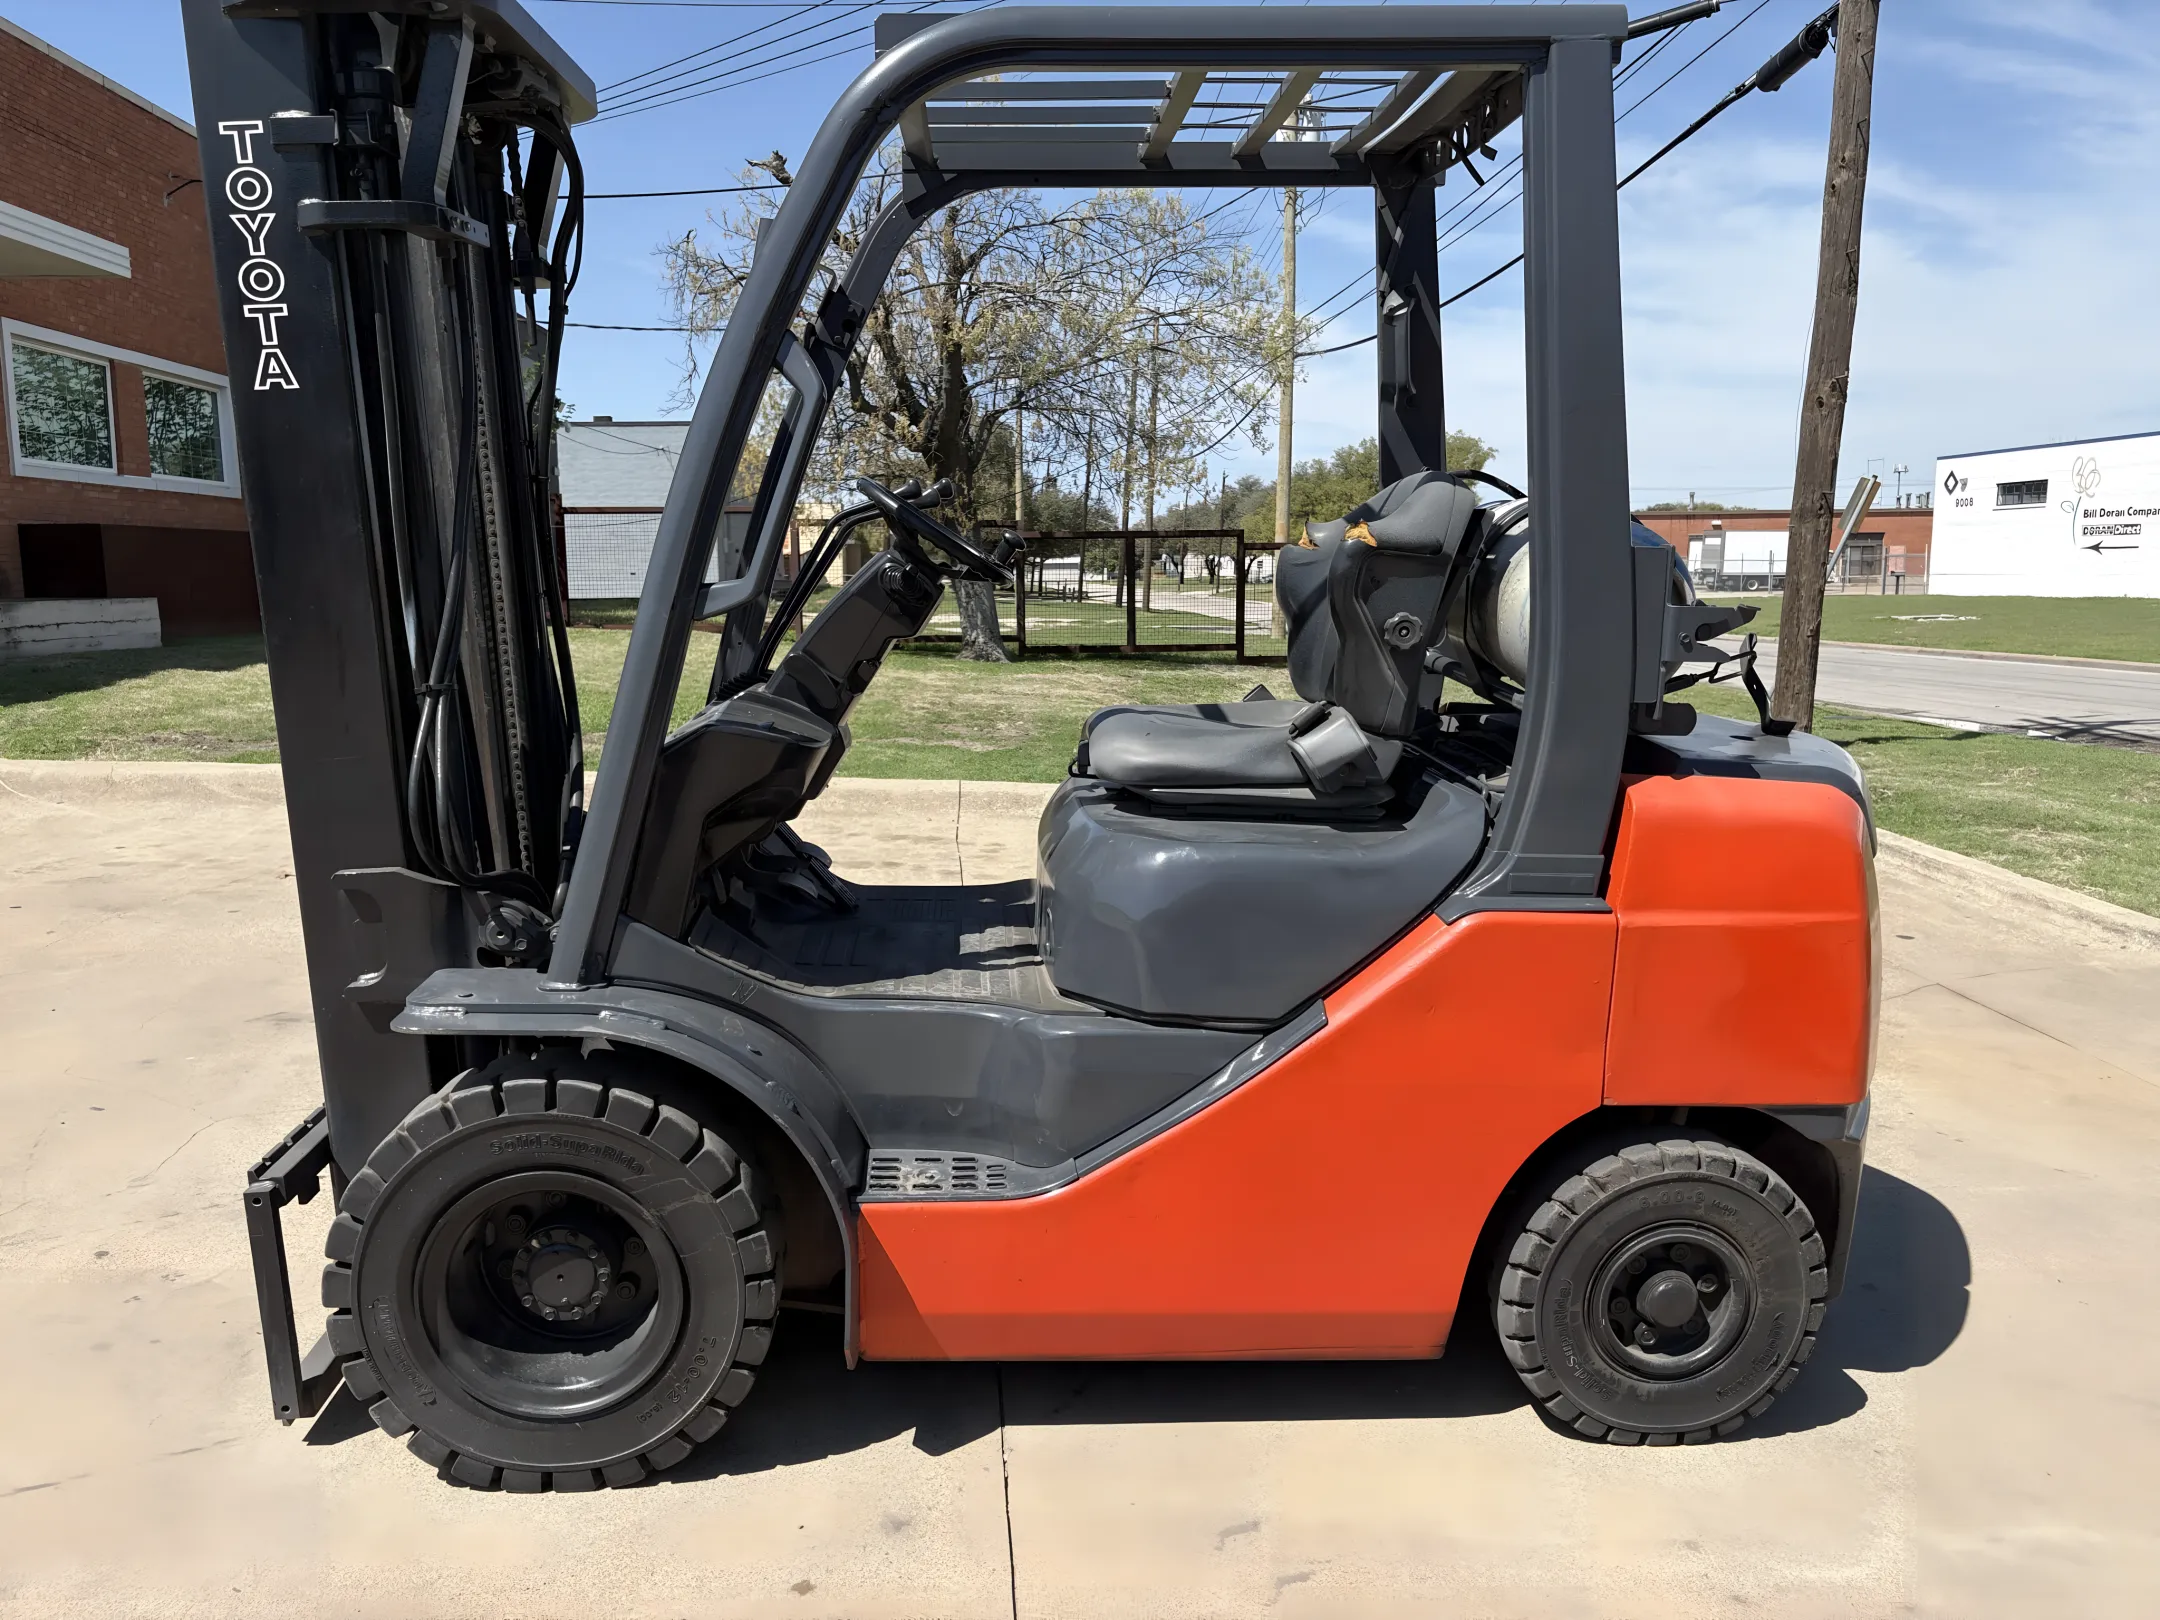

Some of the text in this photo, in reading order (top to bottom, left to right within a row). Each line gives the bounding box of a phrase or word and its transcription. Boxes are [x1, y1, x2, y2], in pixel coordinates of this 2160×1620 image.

[218, 120, 300, 390] TOYOTA
[1956, 497, 1973, 507] 9008
[2083, 509, 2097, 518] Bill
[2099, 507, 2125, 517] Doran
